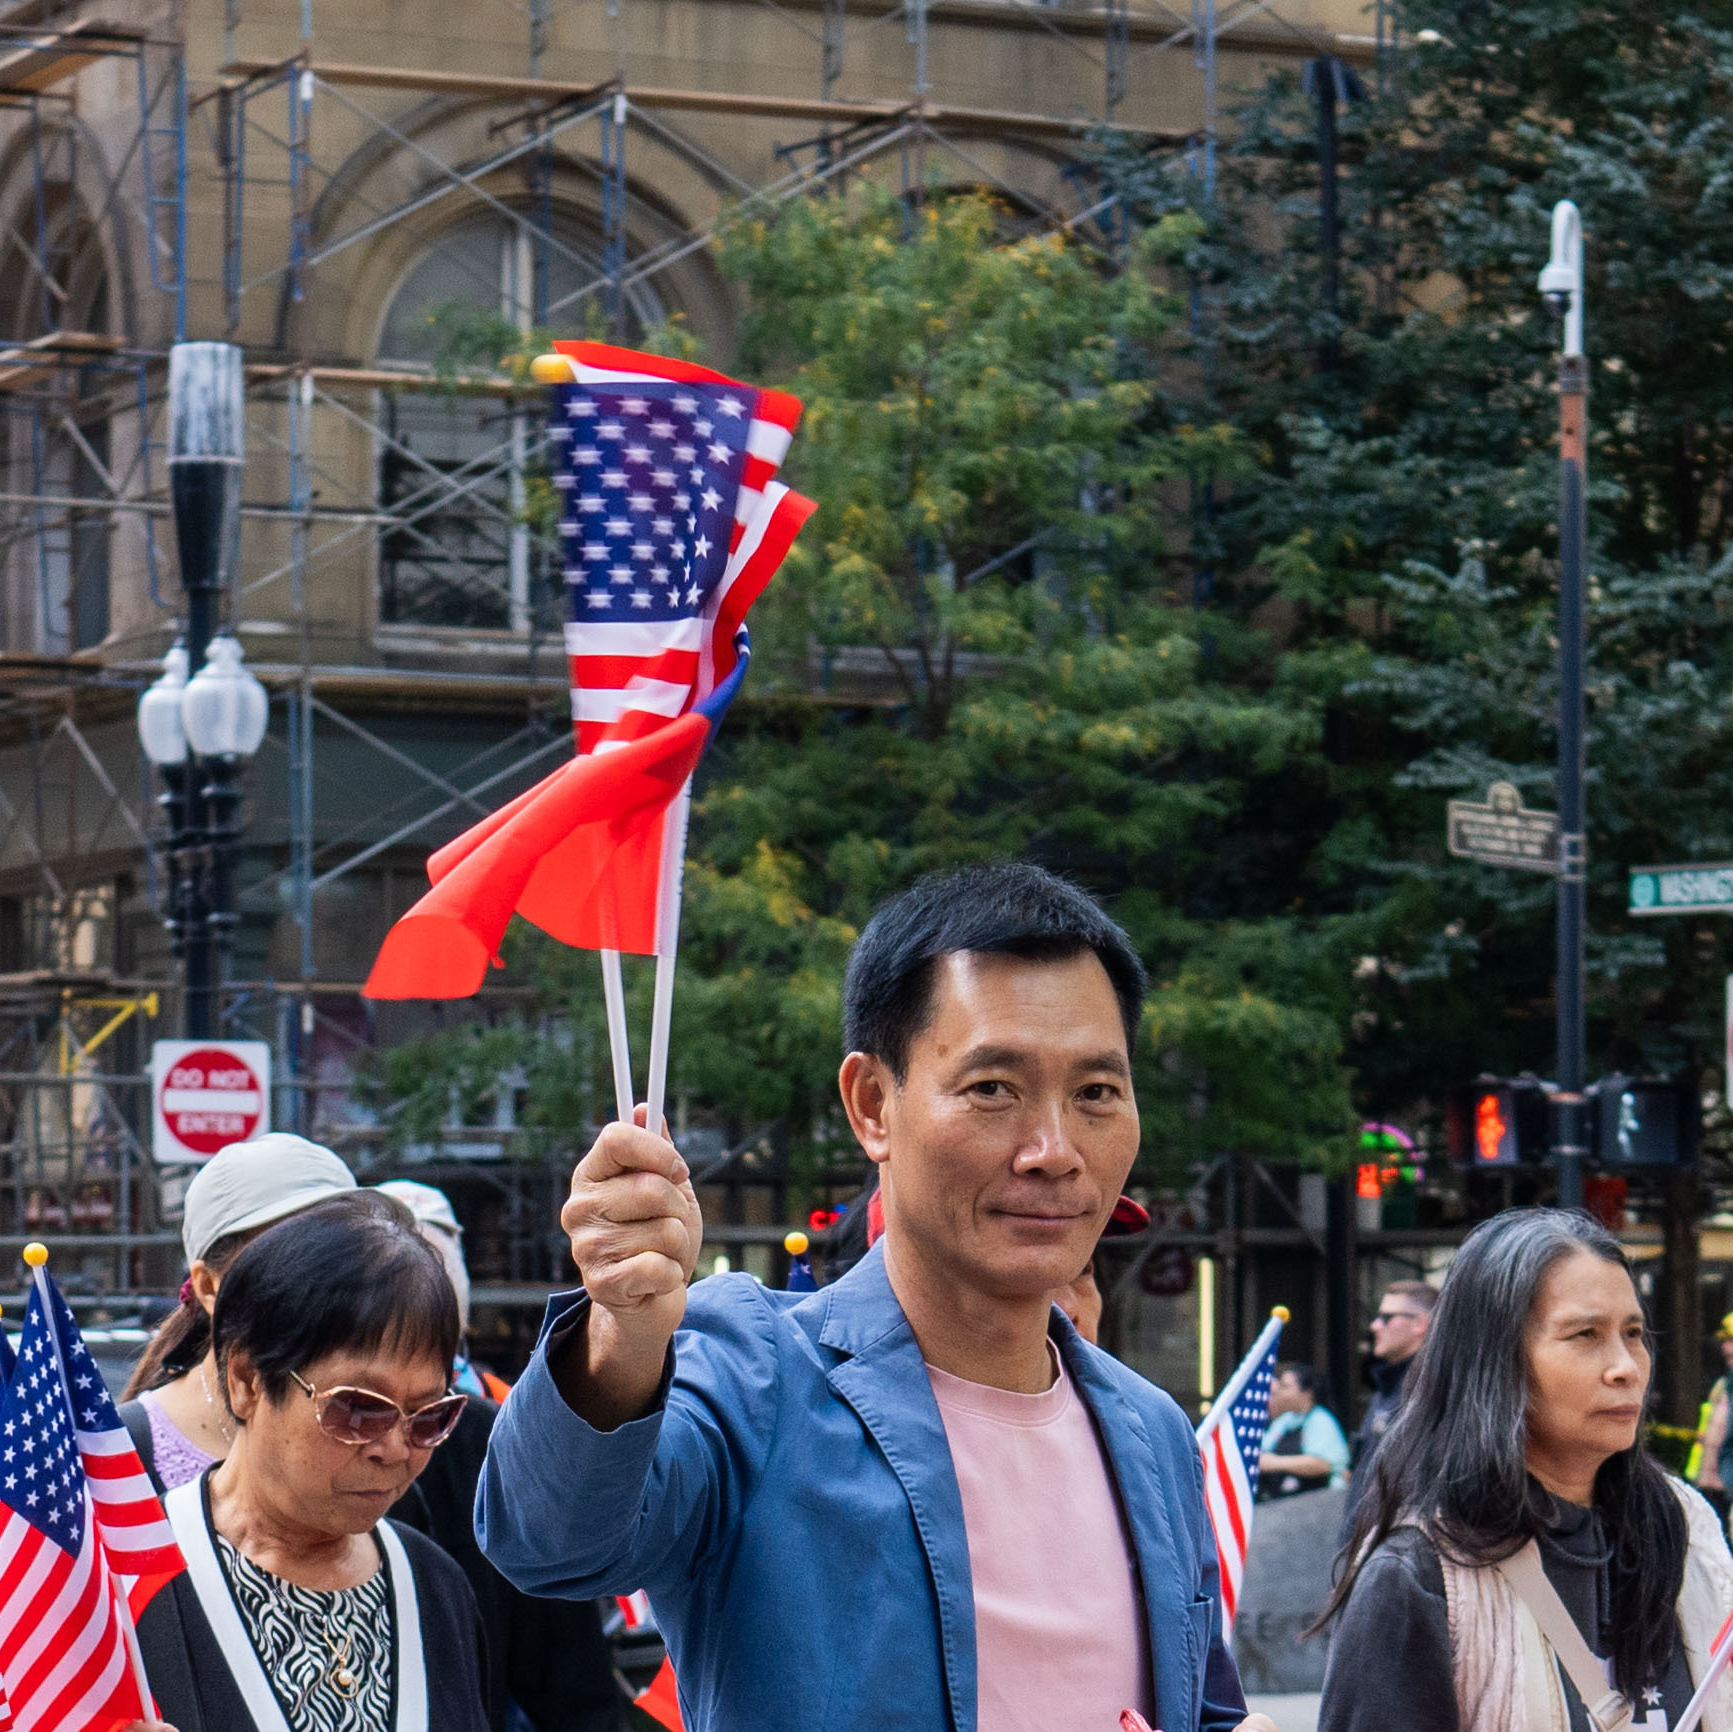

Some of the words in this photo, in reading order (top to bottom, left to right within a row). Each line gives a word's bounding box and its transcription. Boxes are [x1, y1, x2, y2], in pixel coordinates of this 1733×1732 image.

[170, 1068, 204, 1088] DO
[208, 1069, 249, 1089] NOT
[176, 1114, 245, 1135] ENTER
